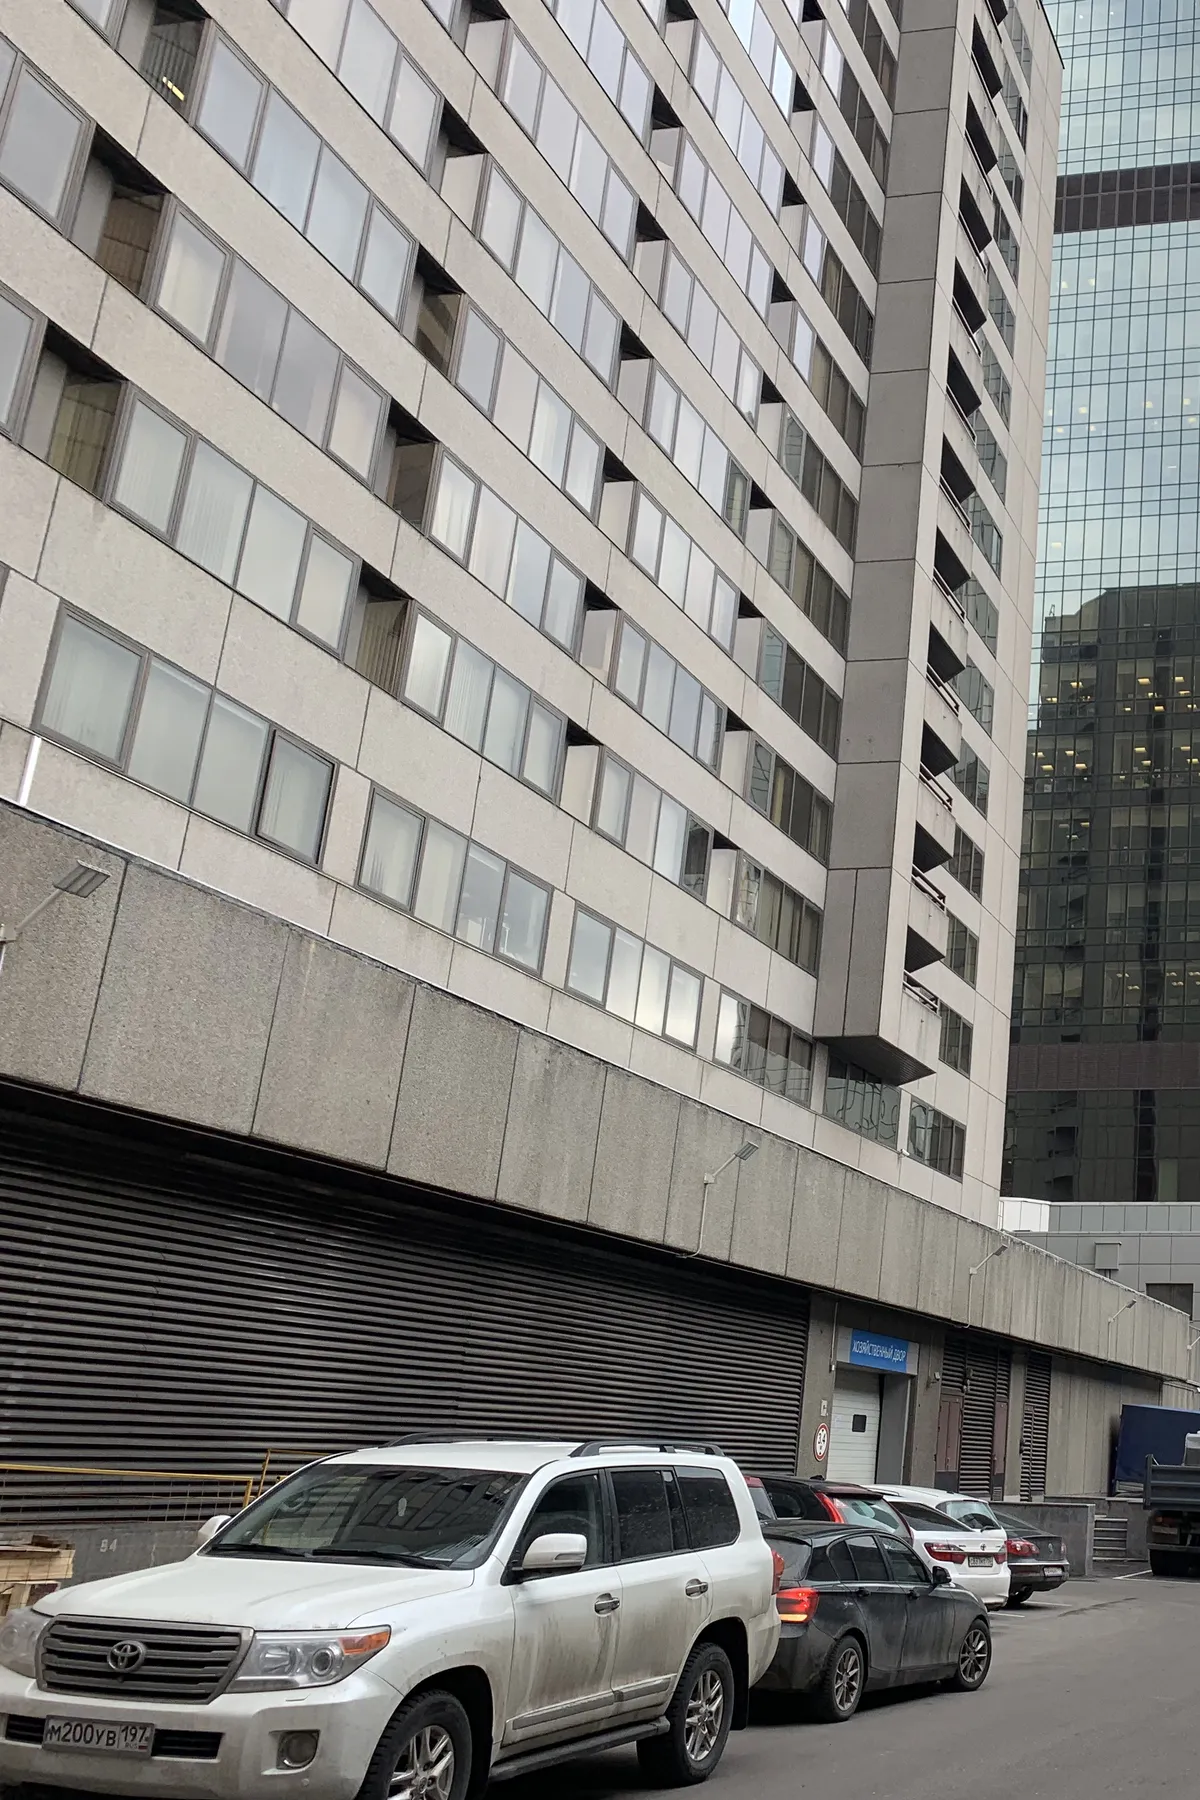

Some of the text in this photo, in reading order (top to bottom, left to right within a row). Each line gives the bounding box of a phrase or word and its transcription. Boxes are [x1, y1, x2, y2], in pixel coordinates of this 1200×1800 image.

[852, 1340, 906, 1362] ХОЗЯЙСТВЕННЫЙ ДВОР
[122, 1726, 148, 1742] 197
